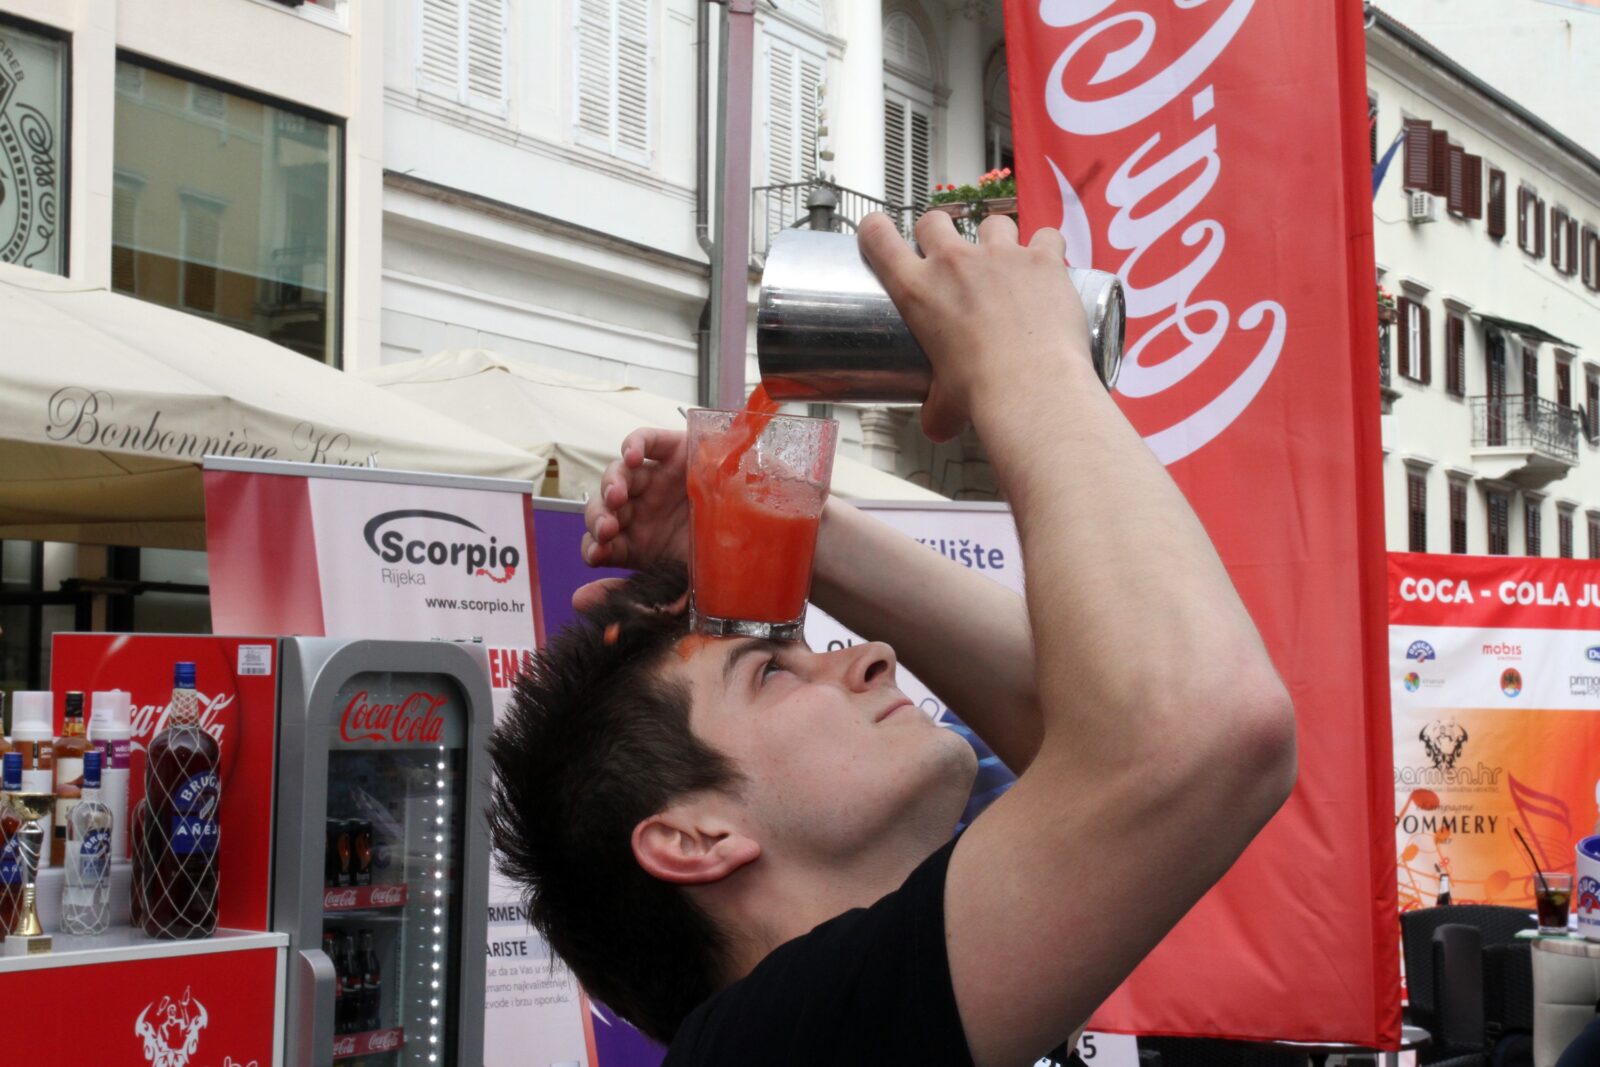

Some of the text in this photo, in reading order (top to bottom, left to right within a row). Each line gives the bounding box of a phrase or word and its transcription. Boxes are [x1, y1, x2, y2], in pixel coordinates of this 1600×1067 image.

[381, 530, 520, 576] Scorpio
[915, 538, 1004, 569] lište
[381, 567, 426, 588] Rijeka
[1400, 577, 1474, 604] COCA
[1498, 581, 1570, 606] COLA
[425, 597, 525, 615] www.scorpio.hr
[1482, 642, 1522, 655] mobis
[339, 690, 450, 743] Coca-Cola
[177, 823, 217, 836] AÑEJ
[488, 906, 528, 922] RMEN
[486, 941, 528, 957] ARISTE
